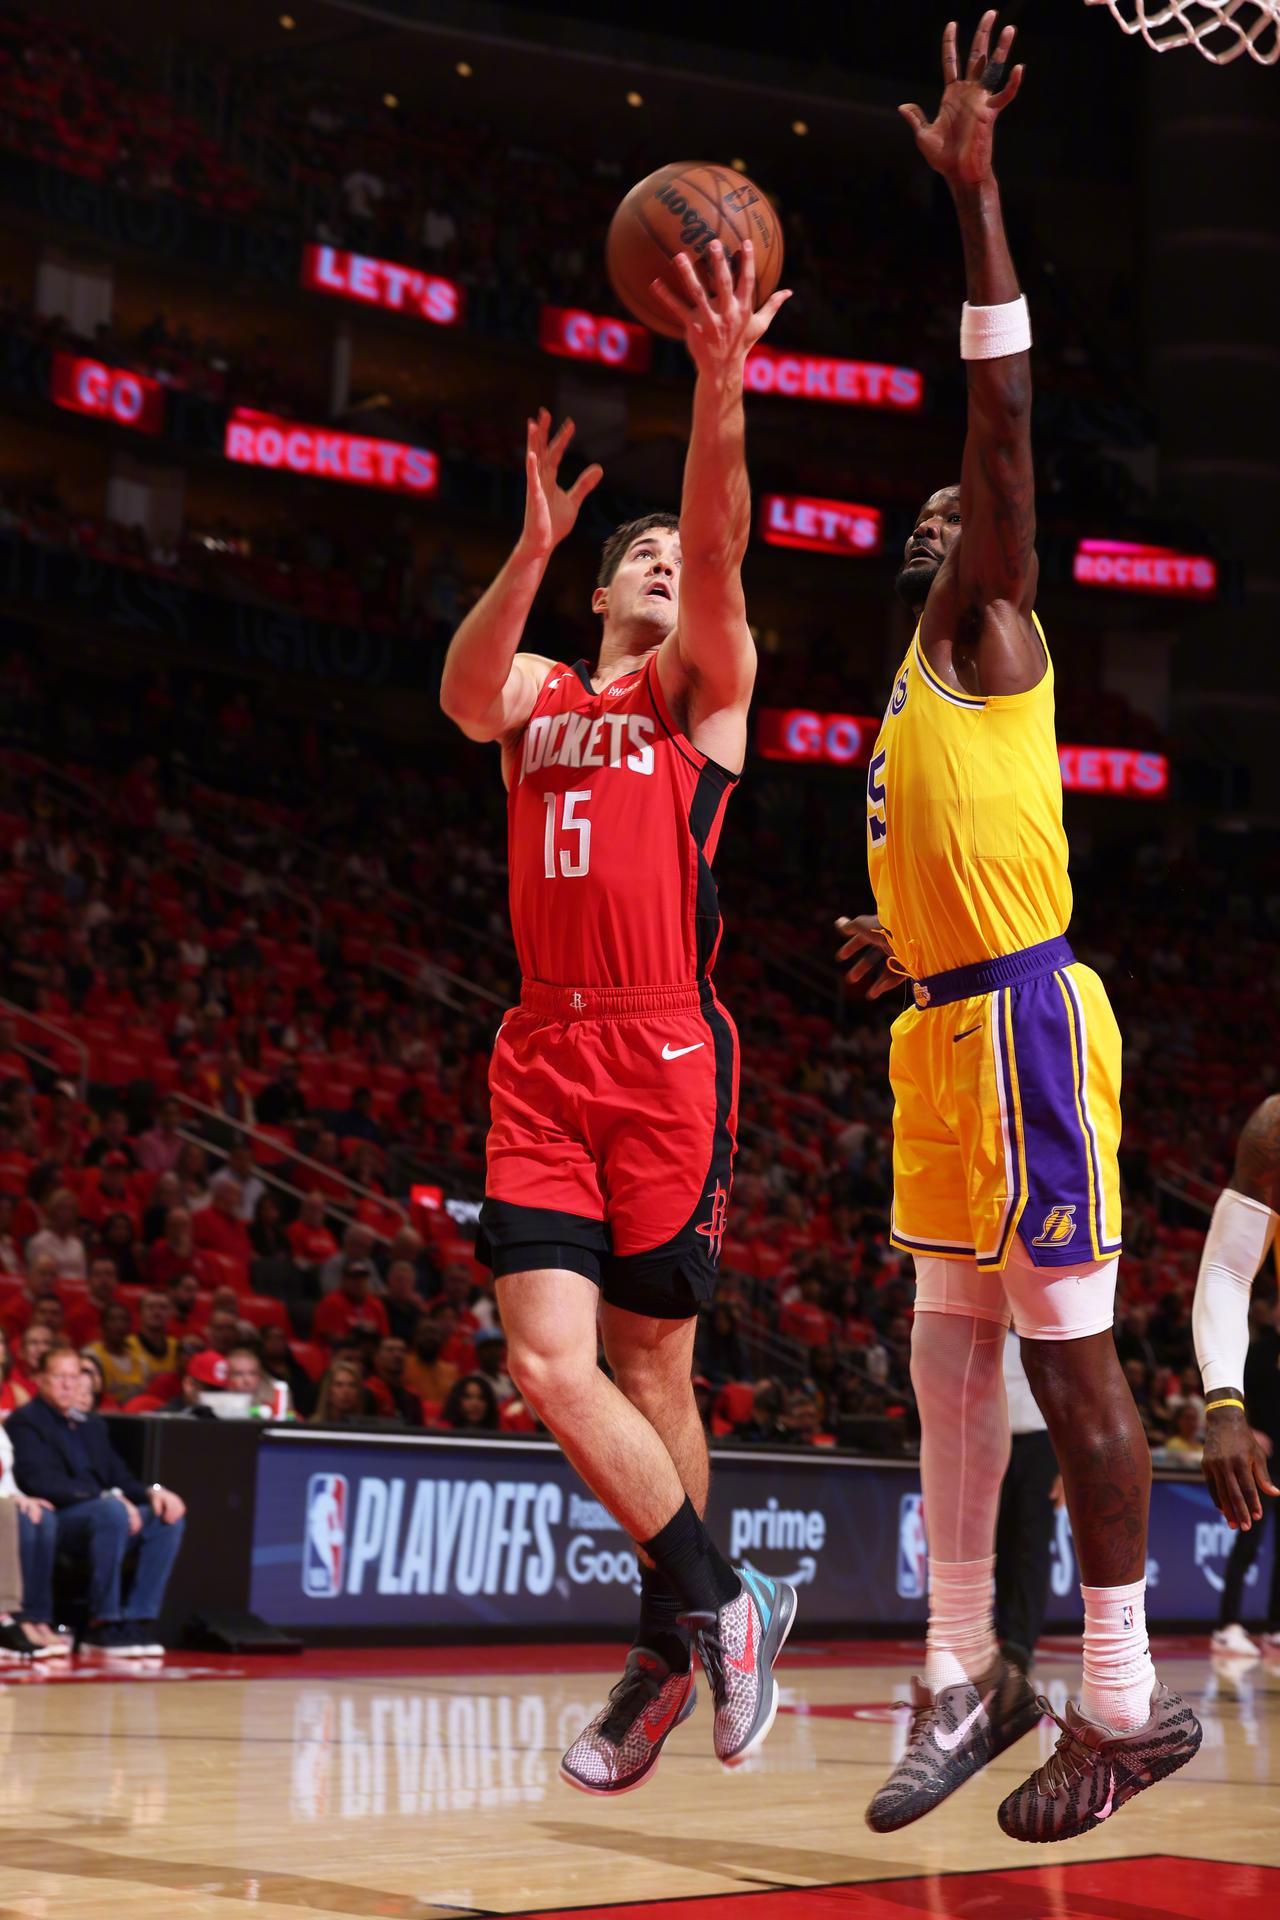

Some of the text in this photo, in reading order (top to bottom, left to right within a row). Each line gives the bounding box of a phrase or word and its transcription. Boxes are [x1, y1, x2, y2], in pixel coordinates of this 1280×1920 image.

[317, 244, 457, 322] LET'S
[565, 314, 628, 362] GO
[78, 364, 142, 420] GO
[743, 357, 919, 405] OCKETS
[227, 424, 433, 486] ROCKETS
[770, 498, 876, 548] LET'S
[1074, 554, 1215, 590] ROCKETS
[786, 714, 860, 761] GO
[1059, 748, 1165, 790] KETS
[543, 789, 592, 878] 15
[346, 1476, 563, 1597] PLAYOFFS
[730, 1498, 826, 1559] prime
[566, 1535, 643, 1596] Goo
